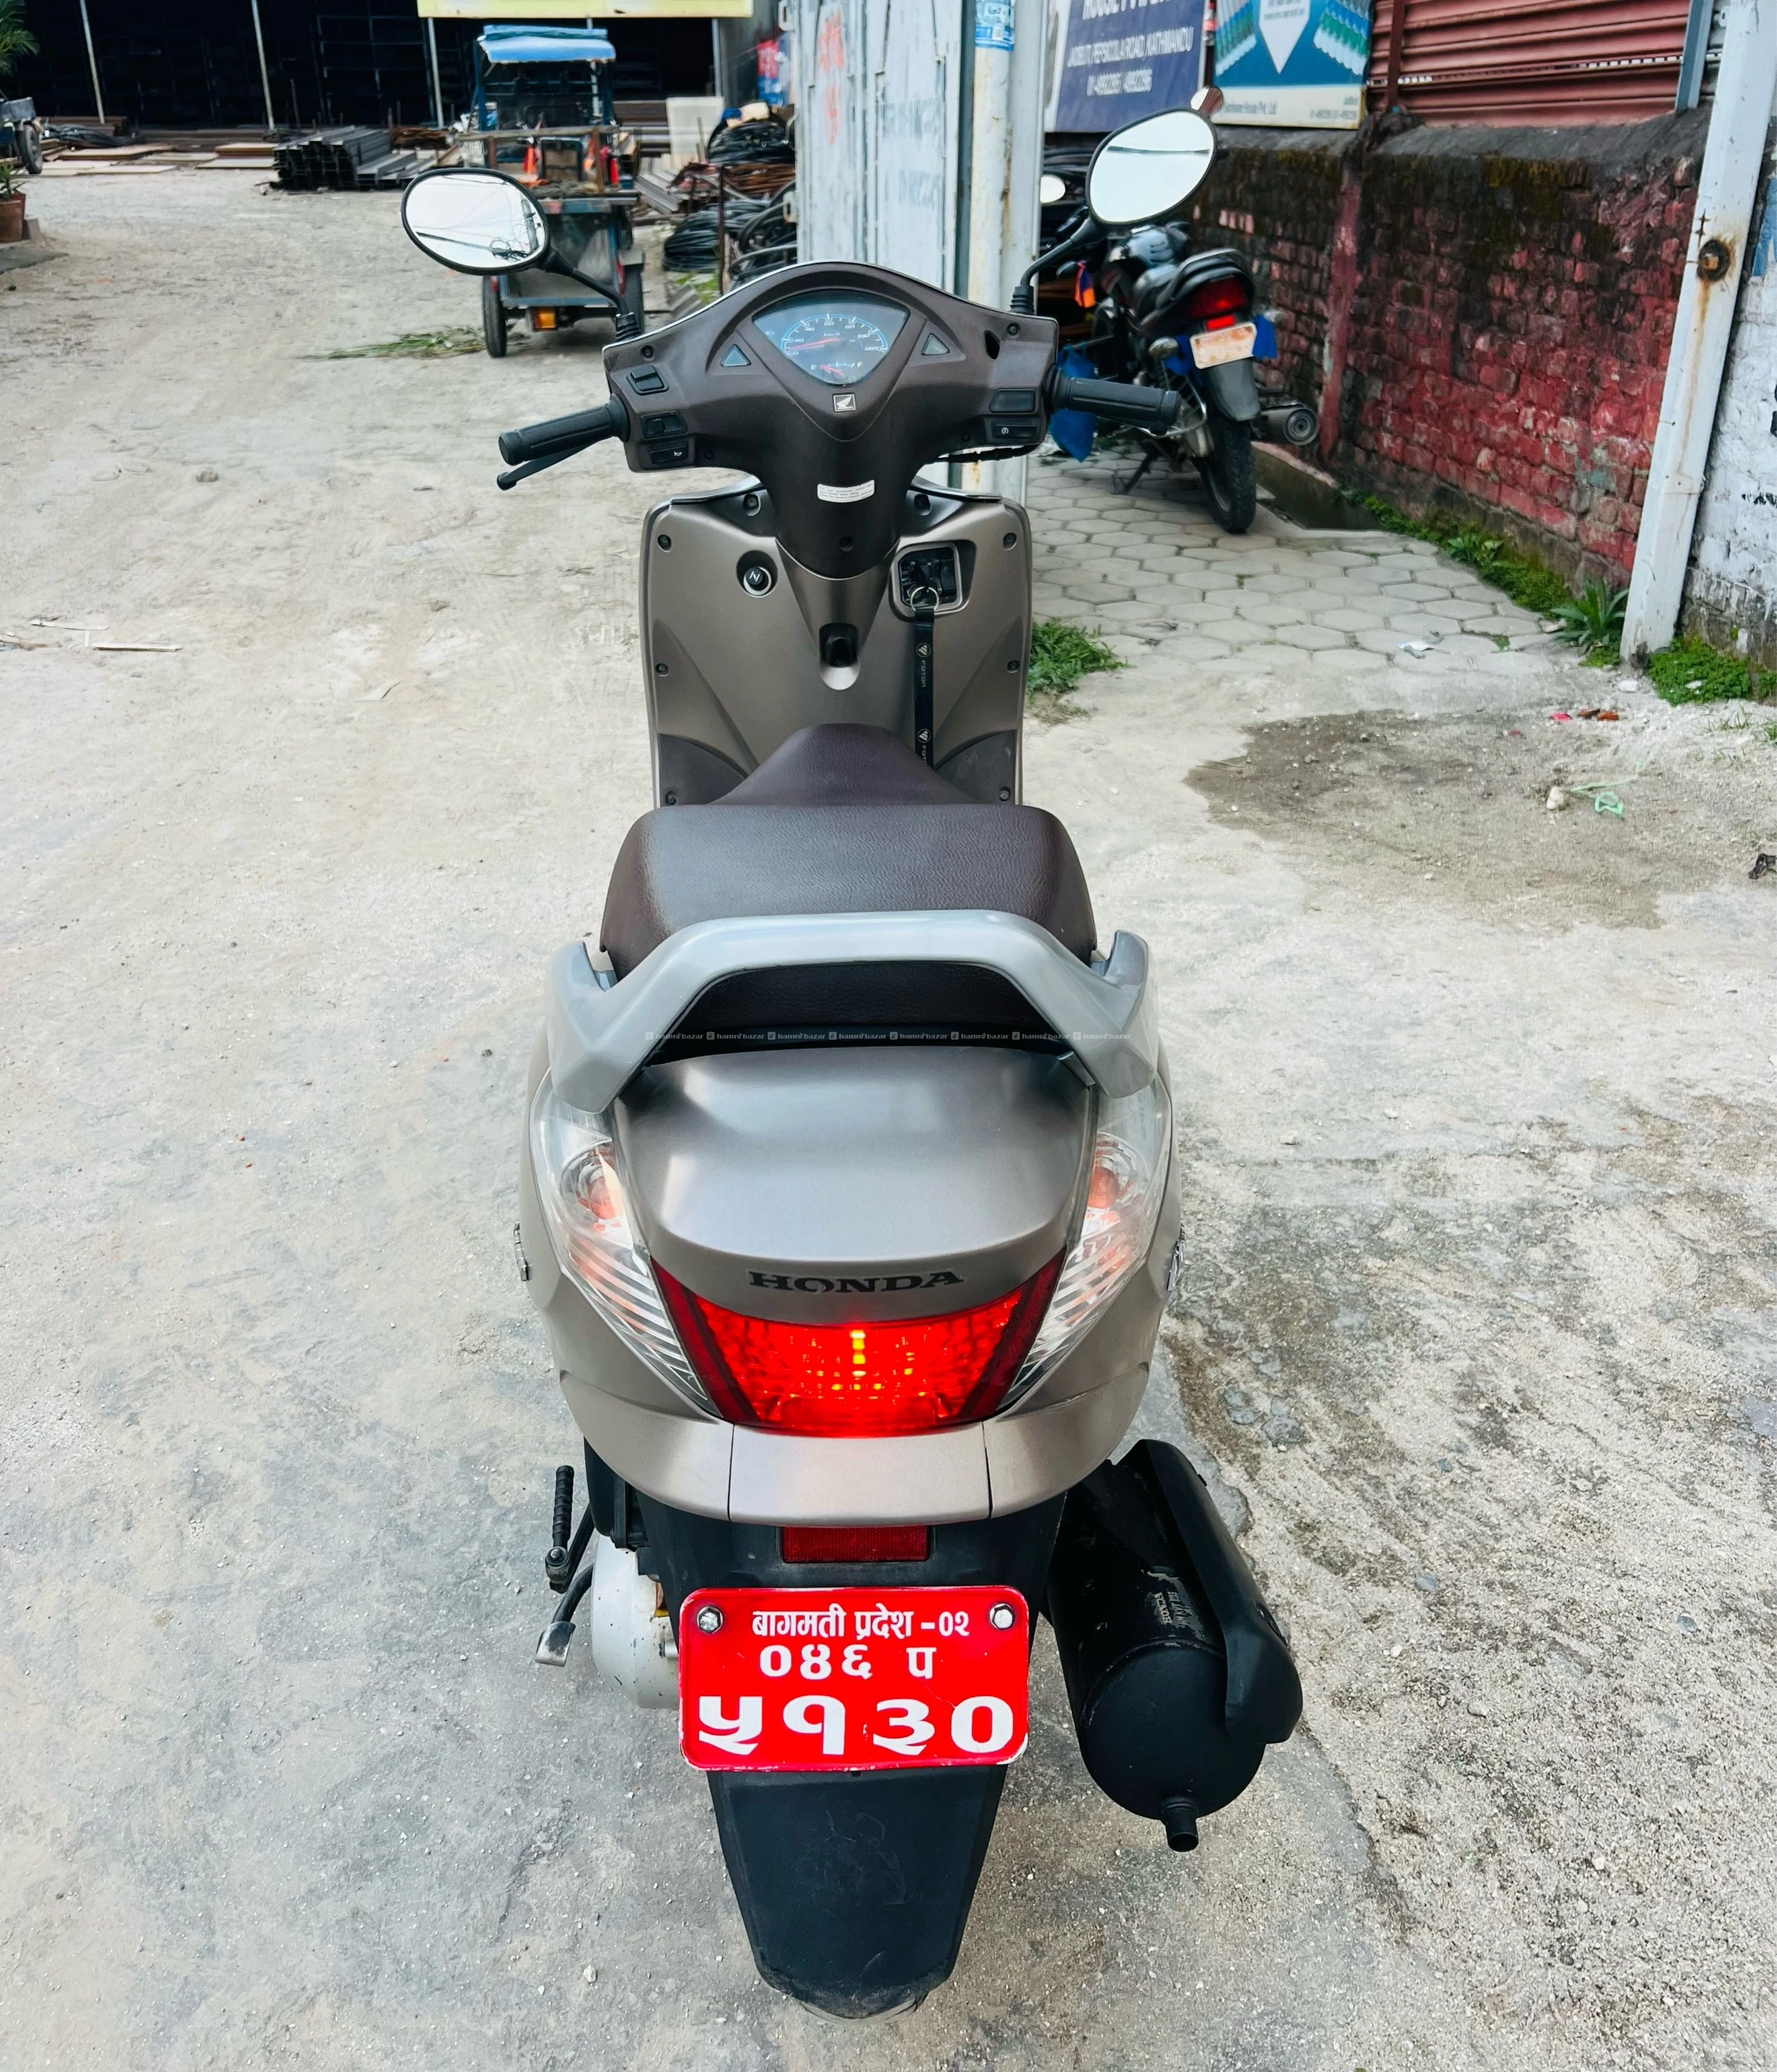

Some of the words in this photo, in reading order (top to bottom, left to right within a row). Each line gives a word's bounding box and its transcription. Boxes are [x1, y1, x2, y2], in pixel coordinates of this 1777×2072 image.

[748, 1270, 964, 1293] HONDA
[752, 1603, 847, 1638] बागमती
[854, 1603, 914, 1640] प्रदेश
[760, 1644, 873, 1680] ०४६
[906, 1647, 937, 1679] प
[699, 1694, 1014, 1756] ५१३०
